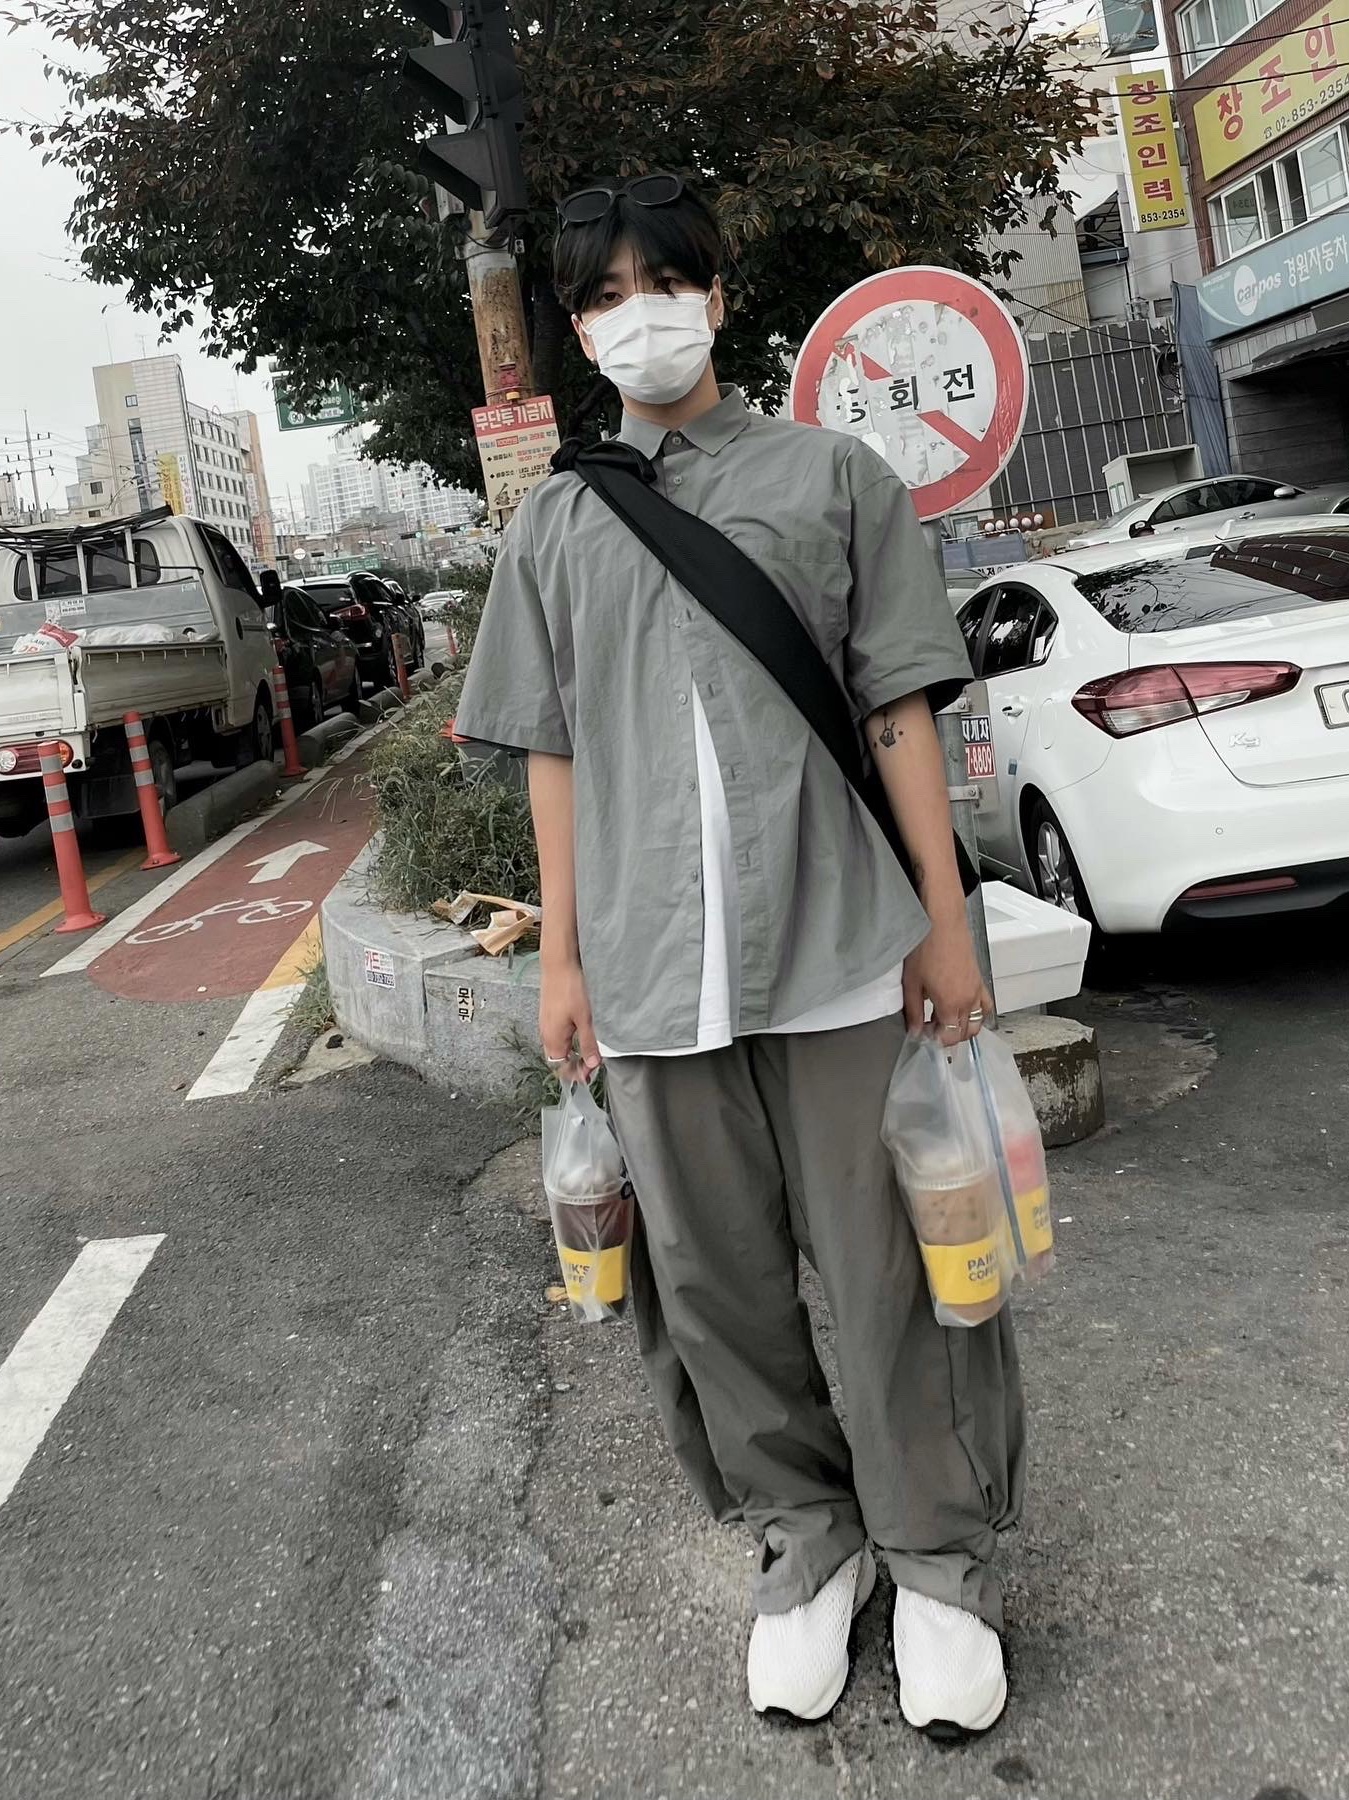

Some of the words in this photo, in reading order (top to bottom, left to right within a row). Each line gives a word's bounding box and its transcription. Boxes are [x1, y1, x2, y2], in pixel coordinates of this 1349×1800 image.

[1127, 80, 1173, 201] 창조인력
[1141, 209, 1185, 223] 853-2354
[1237, 272, 1282, 302] carpos
[474, 401, 553, 430] 무단투기금지
